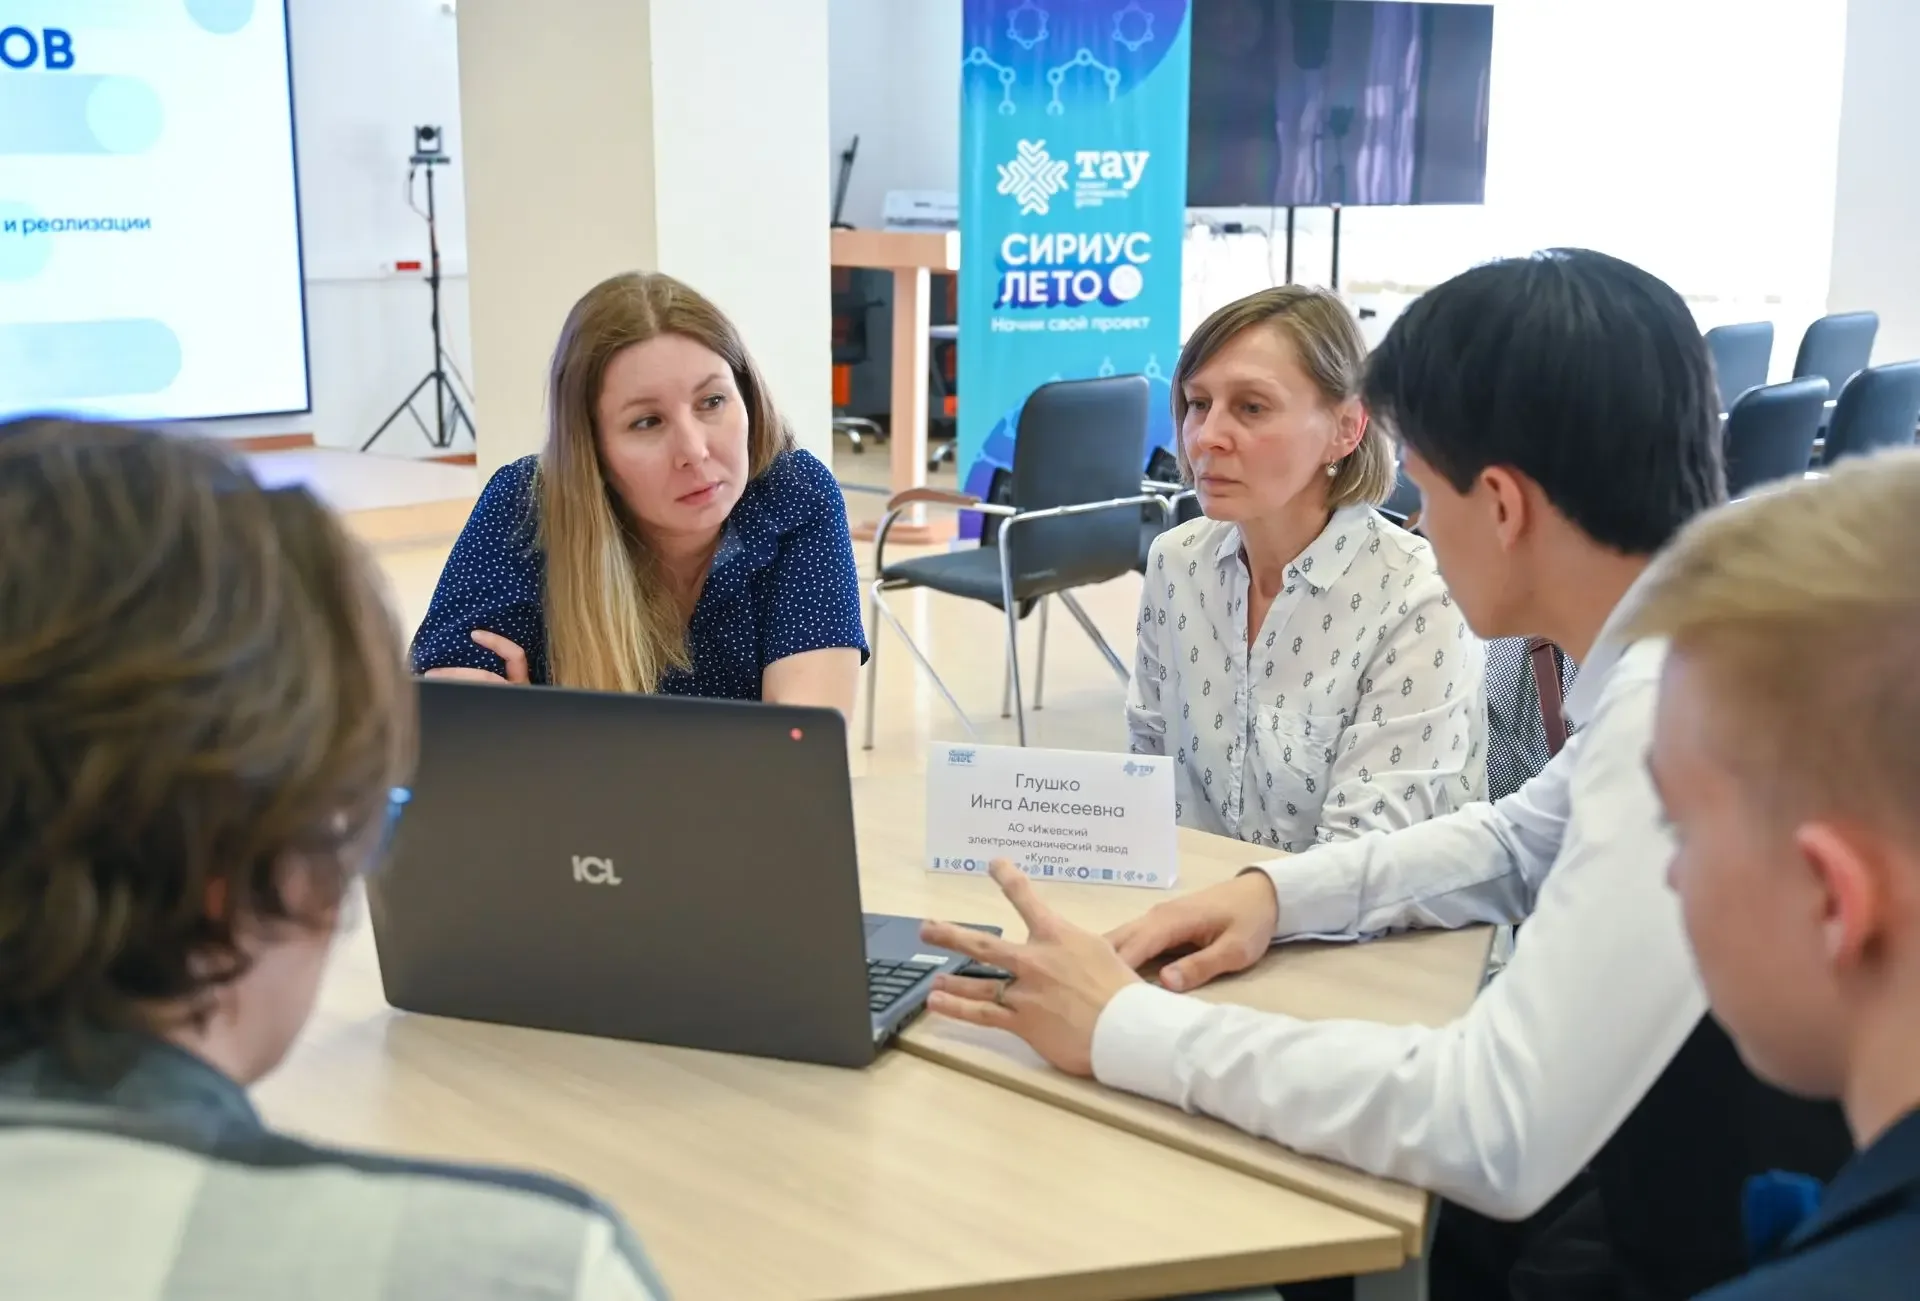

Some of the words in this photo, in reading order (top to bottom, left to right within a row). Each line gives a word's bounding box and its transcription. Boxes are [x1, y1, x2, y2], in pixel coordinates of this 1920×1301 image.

[0, 26, 75, 70] ОВ
[1075, 151, 1150, 190] тау
[4, 219, 17, 232] и
[22, 217, 151, 238] реализации
[1001, 232, 1151, 265] СИРИУС
[1001, 270, 1103, 302] ЛЕТО
[1048, 315, 1088, 331] свой
[1091, 316, 1150, 333] проект
[1015, 773, 1081, 792] Глушко
[970, 793, 1013, 811] Инга
[1017, 796, 1125, 818] Алексеевна
[1007, 823, 1025, 833] АО
[1027, 824, 1088, 838] «Ижевский
[967, 836, 1092, 852] электромеханический
[1095, 844, 1129, 855] завод
[572, 855, 622, 885] ICL
[1025, 852, 1069, 865] «Купол»
